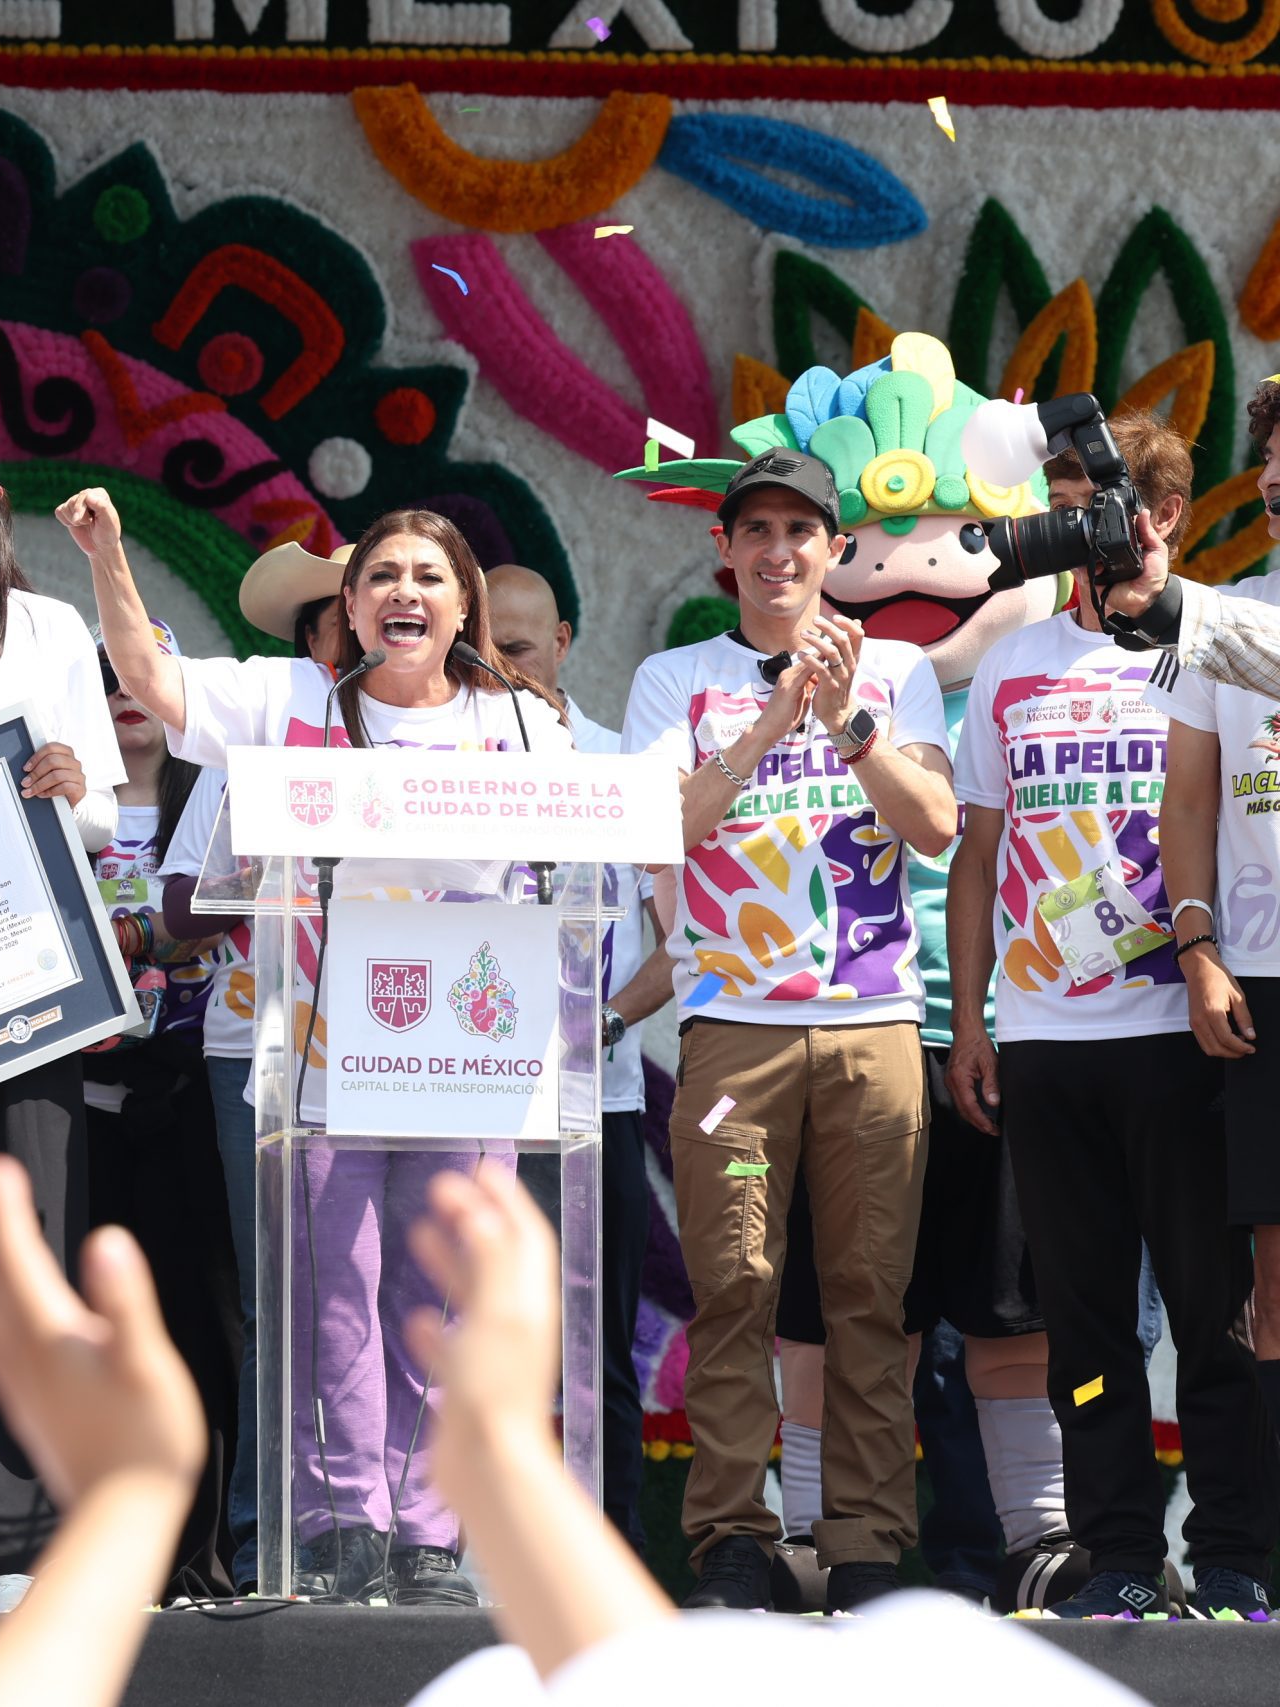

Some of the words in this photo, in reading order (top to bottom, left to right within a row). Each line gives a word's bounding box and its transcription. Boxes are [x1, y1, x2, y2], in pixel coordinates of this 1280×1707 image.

[1026, 705, 1057, 713] Gobierno
[1026, 711, 1066, 723] México
[758, 745, 848, 785] PELO
[1009, 743, 1045, 780] LA
[1055, 740, 1168, 774] PELOT
[403, 778, 537, 796] GOBIERNO
[548, 781, 580, 797] DE
[591, 783, 622, 797] LA
[807, 786, 824, 808] A
[831, 784, 870, 807] CA
[1015, 782, 1098, 811] VUELVE
[1106, 781, 1123, 804] A
[1131, 781, 1164, 803] CA
[1232, 773, 1252, 798] LA
[404, 801, 491, 816] CIUDAD
[500, 802, 528, 817] DE
[537, 800, 624, 819] MÉXICO
[1246, 798, 1271, 816] MÁS
[1094, 900, 1126, 936] 8
[4, 940, 18, 950] 2026
[341, 1055, 422, 1074] CIUDAD
[428, 1057, 456, 1075] DE
[462, 1054, 543, 1077] MÉXICO
[341, 1080, 389, 1091] CAPITAL
[392, 1081, 409, 1092] DE
[413, 1082, 427, 1092] LA
[430, 1081, 543, 1095] TRANSFORMACIÓN
